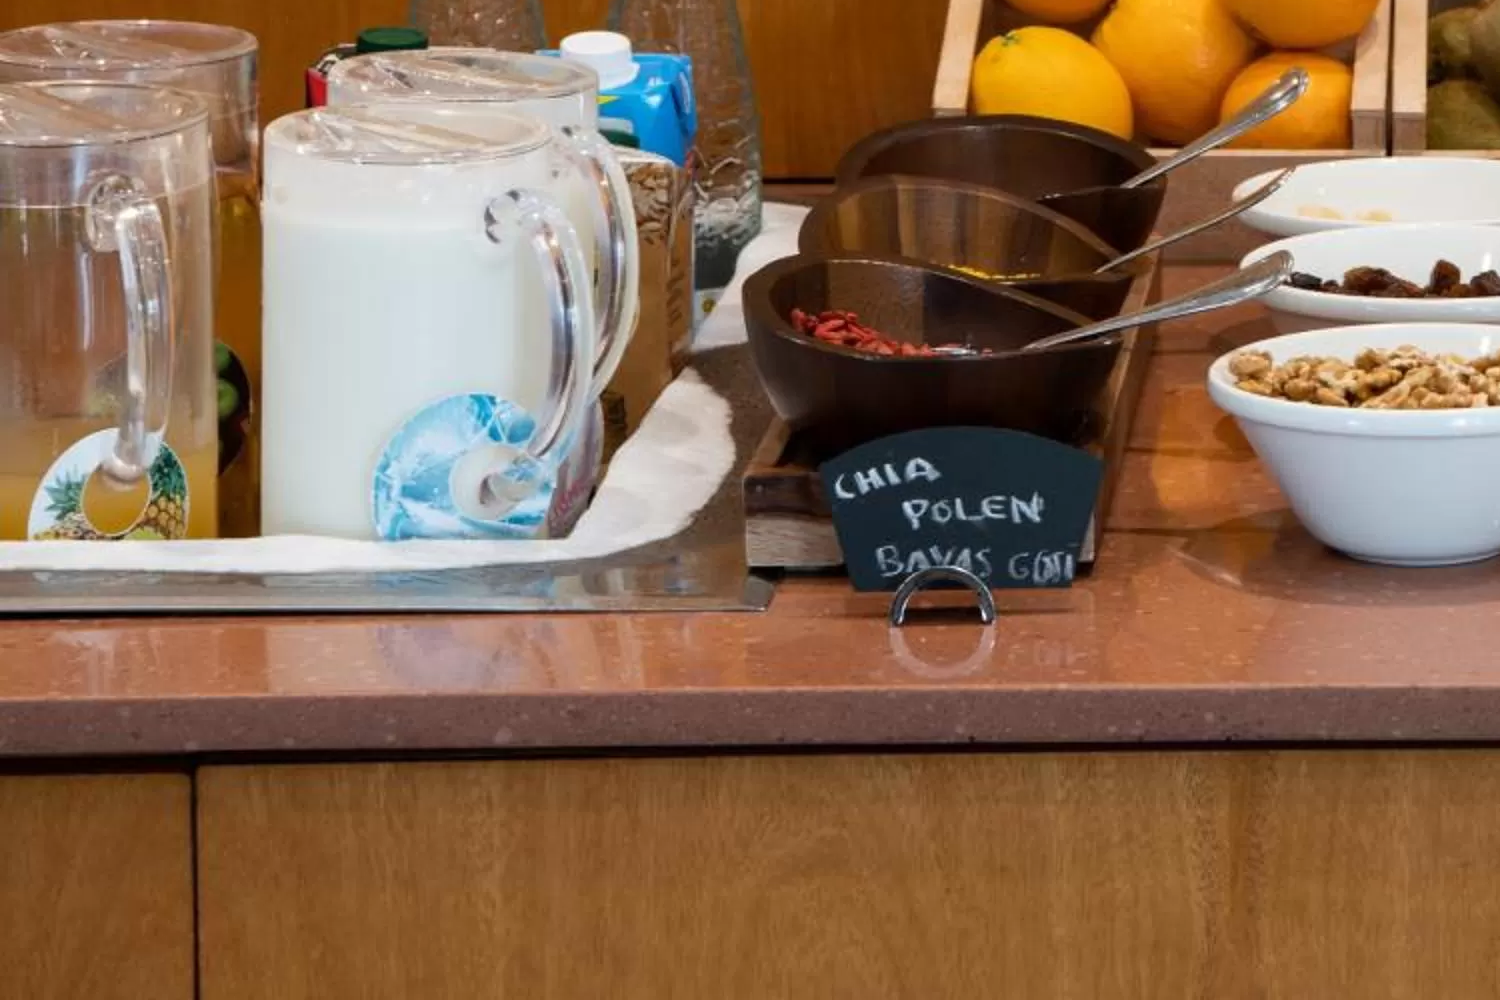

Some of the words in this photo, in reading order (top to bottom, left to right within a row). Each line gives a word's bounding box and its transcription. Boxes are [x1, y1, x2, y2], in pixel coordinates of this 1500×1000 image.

[835, 457, 942, 499] CHIA
[902, 491, 1045, 530] POLEN
[876, 544, 992, 578] BAYAS
